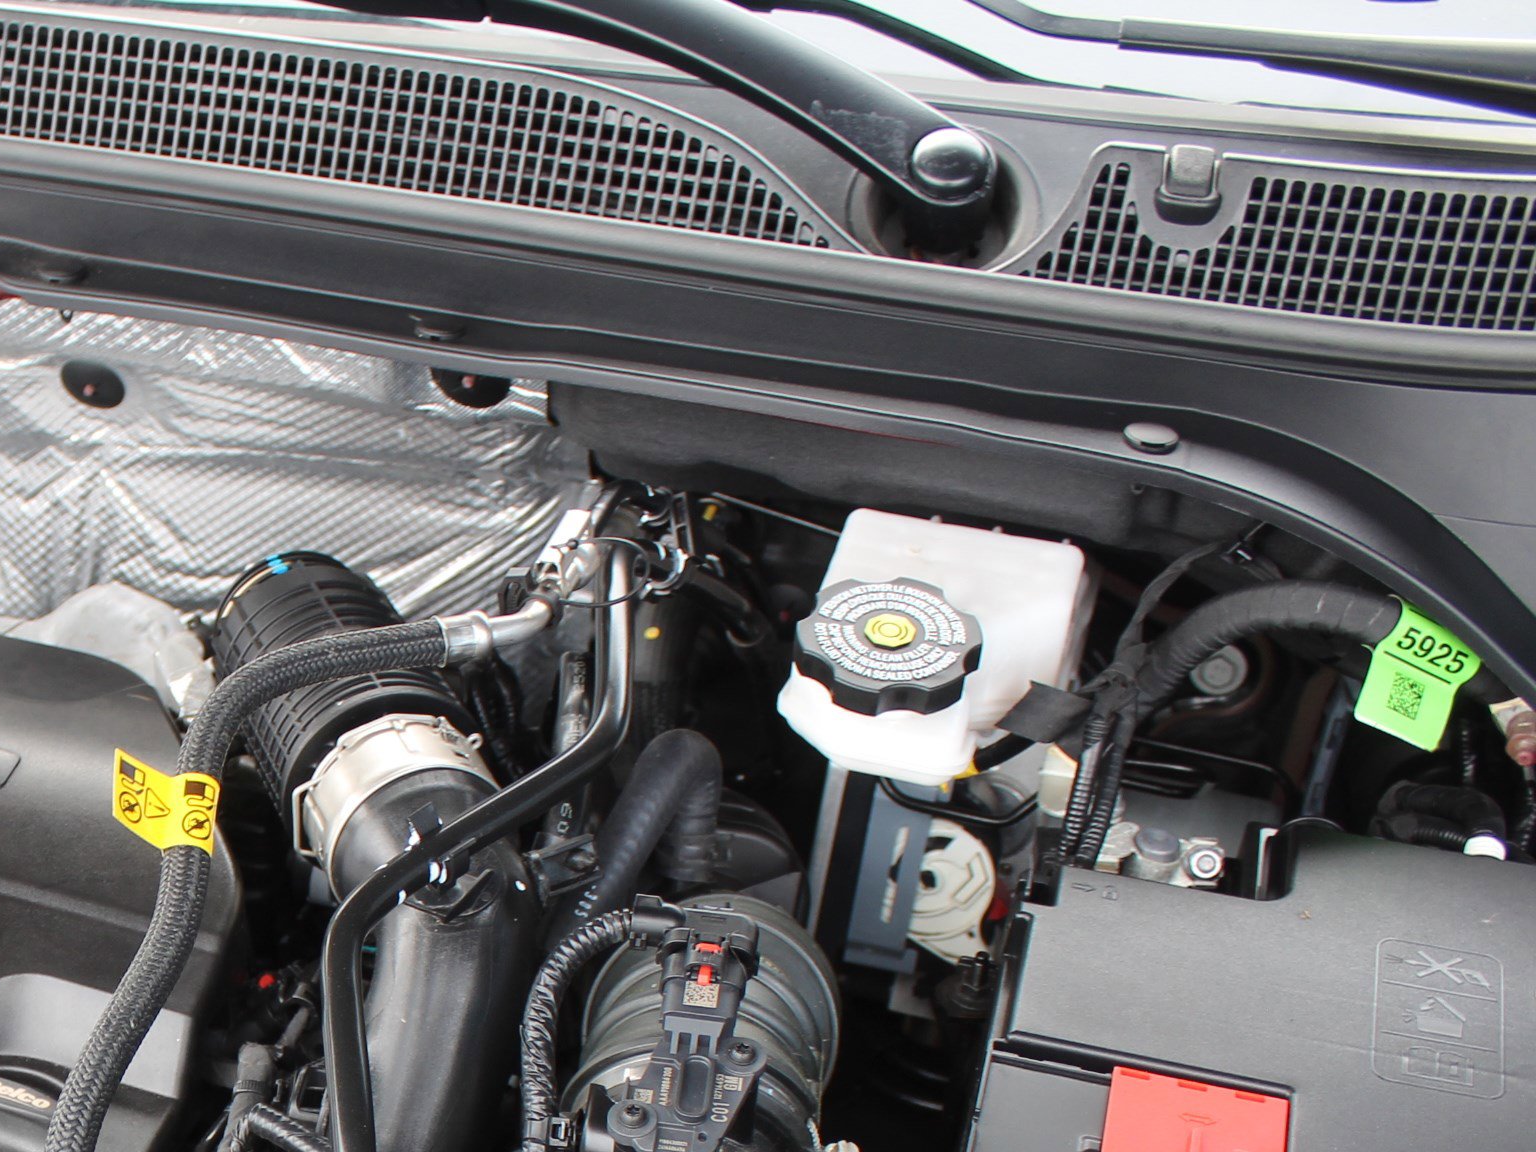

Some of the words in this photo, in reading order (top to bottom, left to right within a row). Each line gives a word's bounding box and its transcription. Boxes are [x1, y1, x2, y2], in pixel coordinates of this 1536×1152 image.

[868, 649, 903, 661] CLEAN
[1396, 627, 1470, 674] 5925
[835, 655, 866, 673] FROM
[871, 669, 914, 680] SEALED
[724, 1075, 742, 1091] GM
